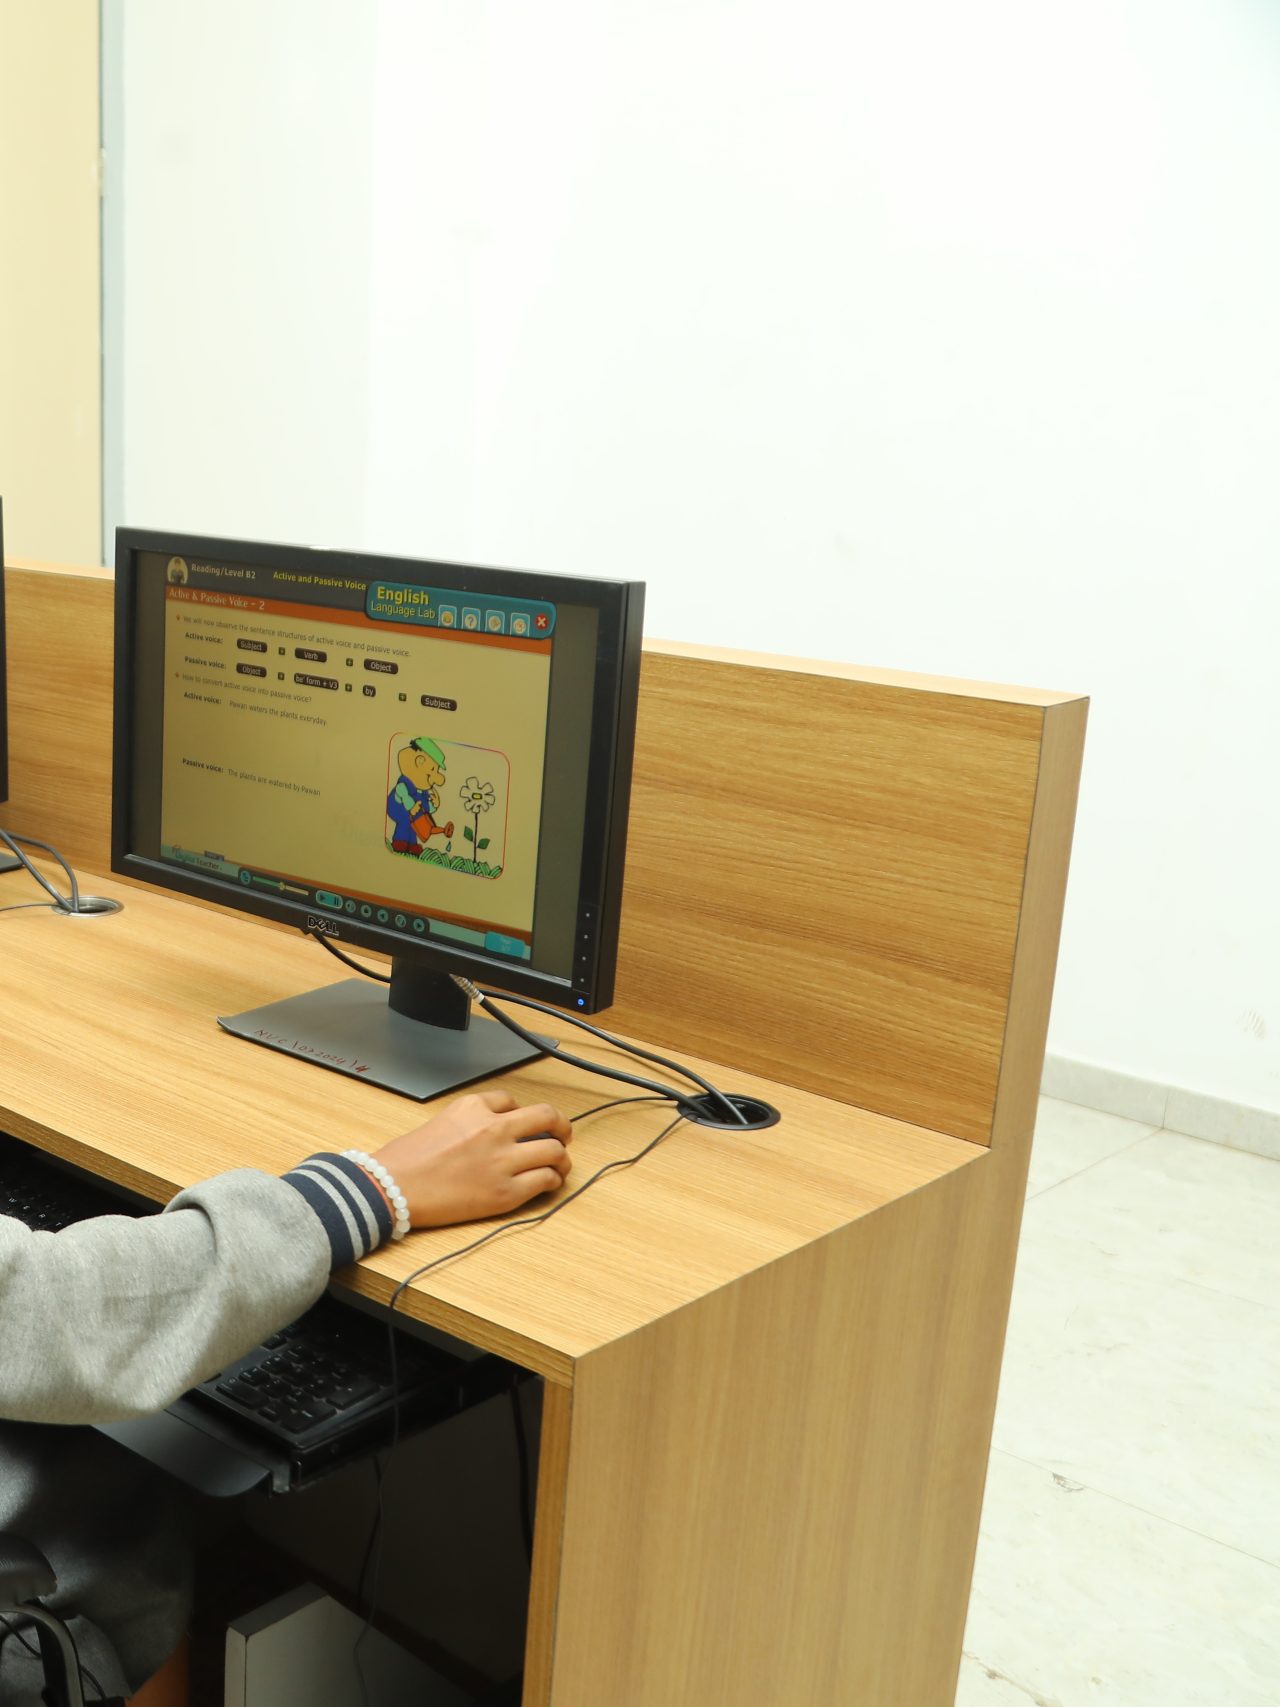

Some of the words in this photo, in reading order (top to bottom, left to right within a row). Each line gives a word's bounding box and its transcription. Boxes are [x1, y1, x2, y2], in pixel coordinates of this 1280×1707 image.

[191, 563, 244, 578] Reading/Level
[246, 570, 256, 579] B2
[273, 571, 296, 581] Active
[298, 574, 312, 584] and
[313, 576, 343, 587] Passive
[344, 579, 366, 590] Voice
[169, 589, 189, 599] Active
[192, 591, 199, 600] &
[200, 592, 226, 605] Passive
[228, 595, 248, 608] Voice
[259, 601, 265, 610] 2
[376, 586, 429, 605] English
[370, 601, 415, 618] Language
[418, 607, 435, 618] Lab
[185, 632, 203, 641] Active
[204, 635, 223, 644] voice:
[215, 620, 238, 630] observe
[239, 623, 249, 632] the
[250, 626, 275, 636] sentence
[277, 629, 308, 641] structures
[308, 634, 315, 642] of
[316, 636, 334, 646] active
[335, 640, 352, 648] voice
[353, 641, 365, 650] and
[366, 644, 390, 655] passive
[392, 648, 411, 657] voice.
[185, 656, 207, 667] Passive
[208, 659, 226, 669] voice:
[240, 640, 262, 651] Subject
[303, 652, 319, 660] Verb
[370, 660, 392, 672] Object
[202, 677, 223, 687] convert
[224, 681, 241, 690] active
[242, 684, 256, 694] voice
[257, 687, 269, 695] into
[270, 689, 292, 700] passive
[293, 693, 312, 703] voice?
[242, 665, 261, 675] Object
[306, 676, 321, 687] form
[328, 681, 338, 689] V3
[365, 687, 374, 697] by
[424, 697, 451, 709] Subject
[184, 692, 202, 702] Active
[203, 695, 222, 705] voice:
[249, 704, 268, 714] waters
[269, 707, 279, 716] the
[280, 709, 298, 721] plants
[182, 758, 205, 769] Passive
[206, 763, 224, 774] voice:
[228, 768, 238, 777] The
[239, 770, 256, 782] plants
[257, 776, 267, 784] are
[268, 777, 291, 790] watered
[293, 783, 300, 793] by
[301, 785, 321, 796] Pawan
[307, 914, 340, 936] DELL
